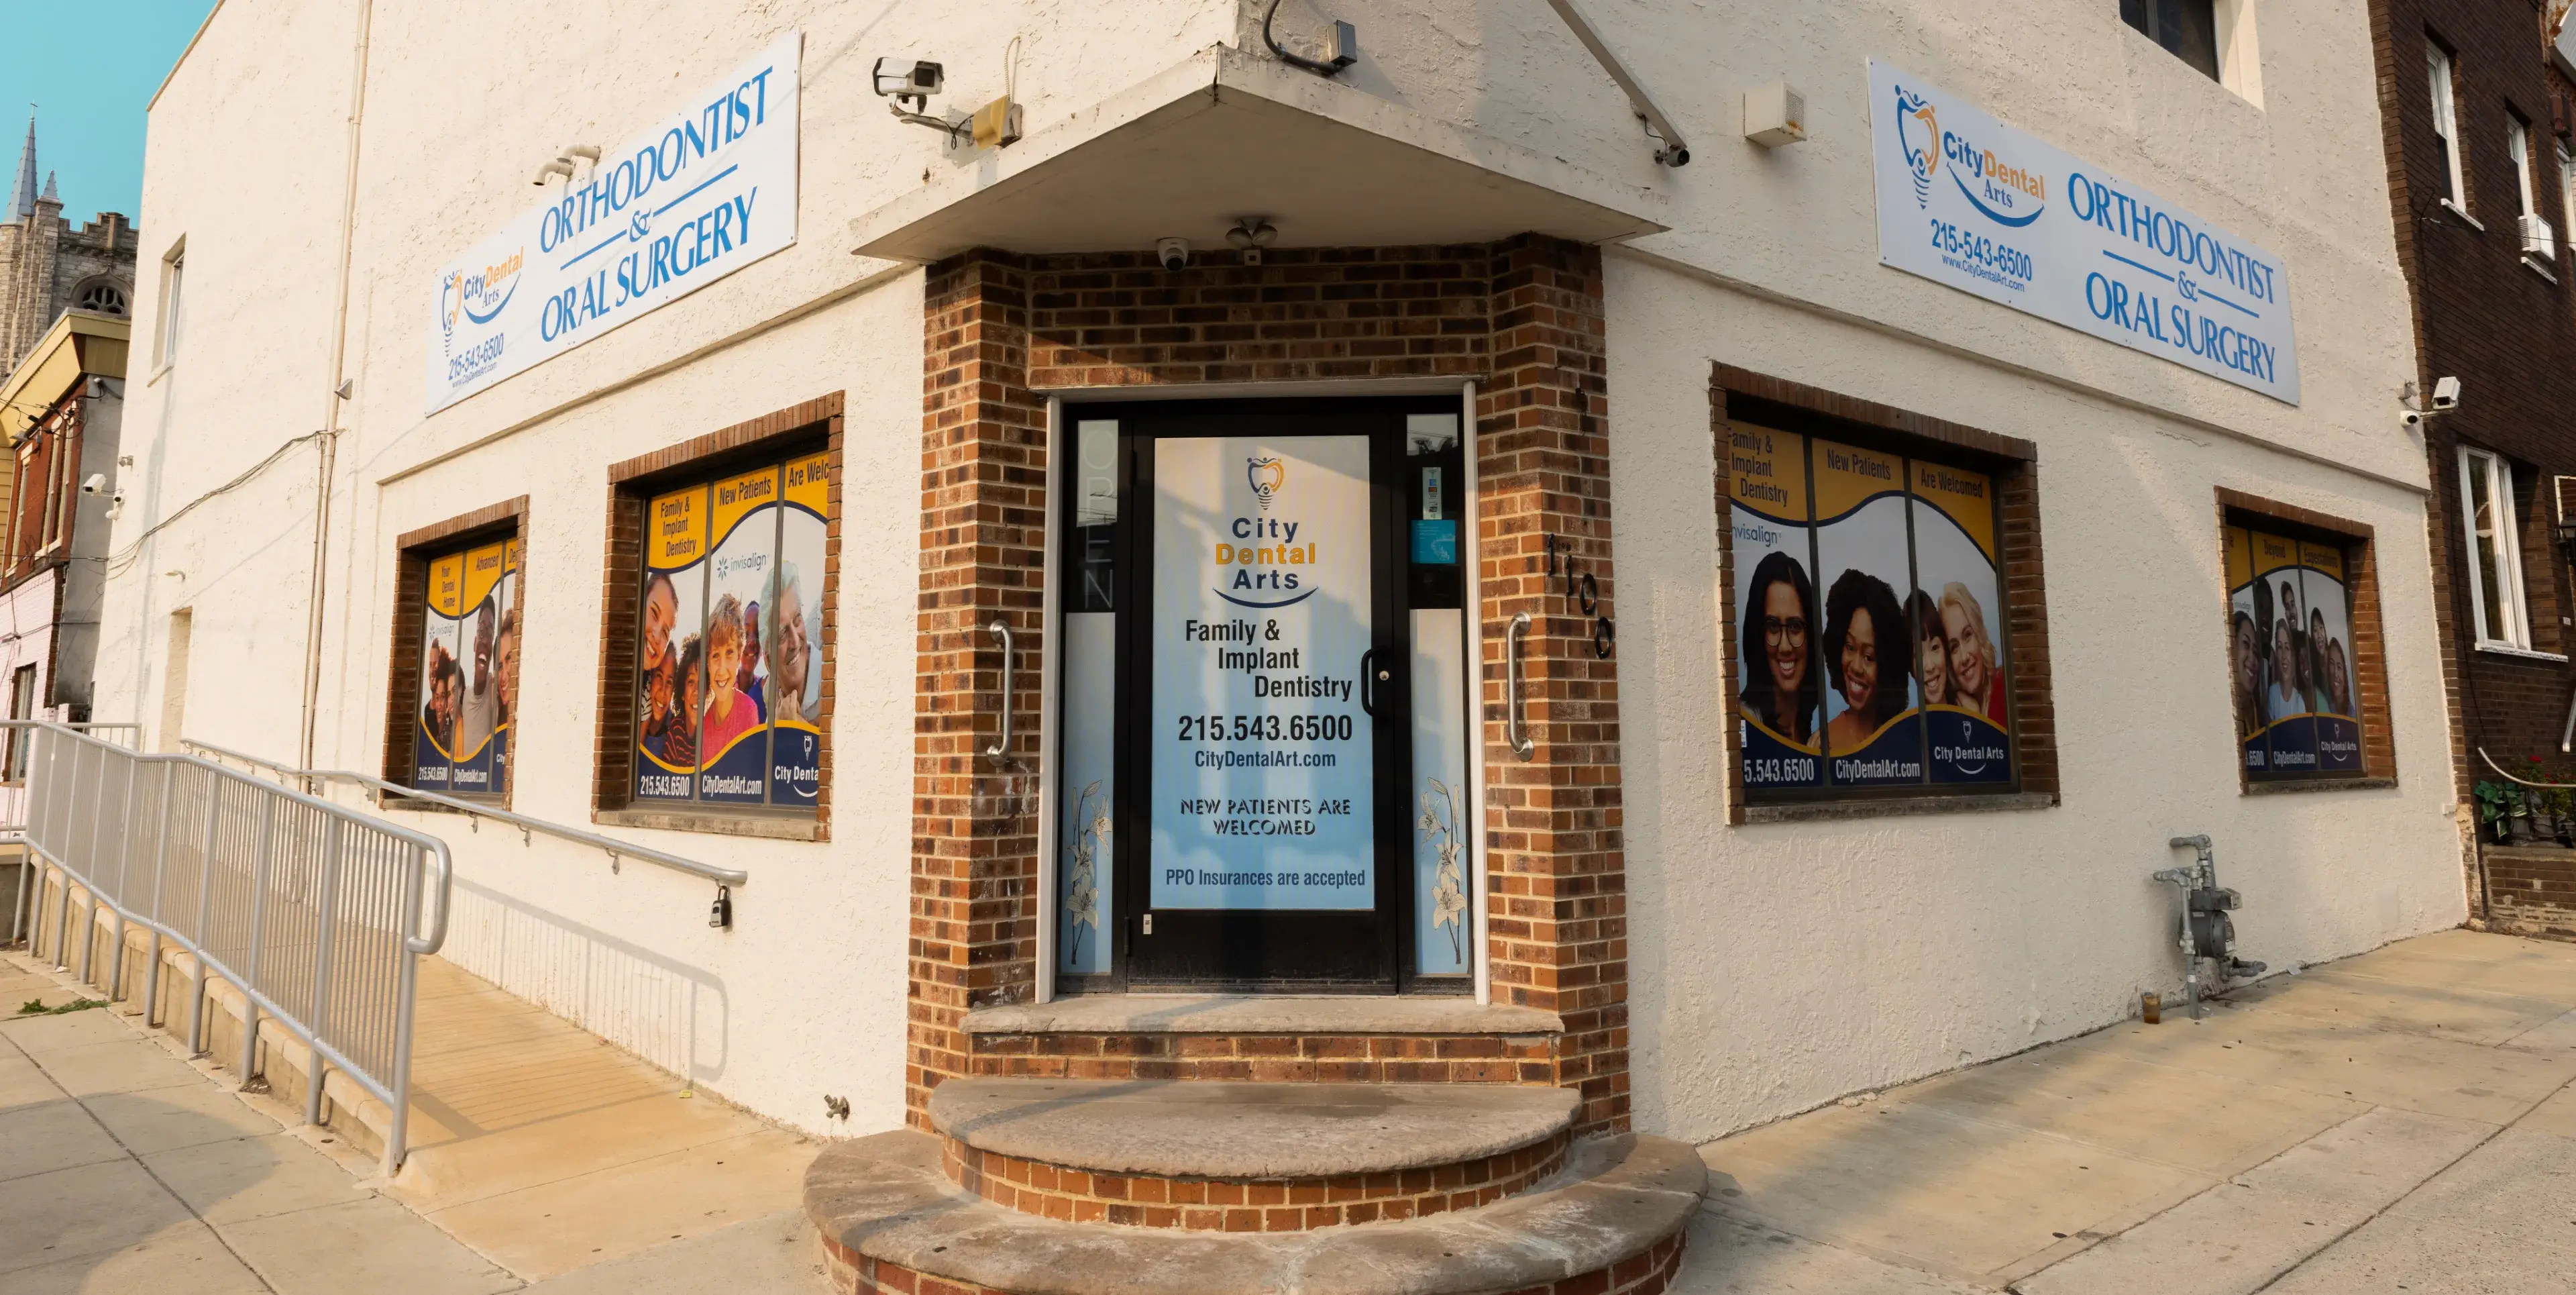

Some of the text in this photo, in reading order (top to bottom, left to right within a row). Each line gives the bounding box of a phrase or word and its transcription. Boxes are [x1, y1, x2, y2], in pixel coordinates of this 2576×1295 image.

[540, 66, 773, 254] ORTHODONTIST
[1984, 178, 2012, 208] Arts
[630, 209, 653, 242] &
[1931, 218, 2032, 281] 215-543-6500
[2068, 172, 2273, 304] ORTHODONTIST
[541, 186, 757, 342] ORAL SURGERY
[1942, 254, 2025, 292] www.CityDentalArt.com
[482, 288, 500, 308] Arts
[2178, 271, 2198, 301] &
[2086, 272, 2275, 383] ORAL SURGERY
[448, 333, 504, 380] 215-543-6500
[452, 362, 497, 388] www.CityDentalArt.com
[1766, 435, 1773, 454] &
[1731, 452, 1772, 477] Implant
[1827, 448, 1891, 480] New Patients
[788, 467, 803, 488] Are
[1921, 468, 1983, 498] Are Welcomed
[719, 476, 771, 506] New Patients
[1740, 478, 1787, 507] Dentistry
[660, 497, 690, 519] Family &
[1083, 429, 1118, 609] OPEN
[663, 517, 688, 538] Implant
[1232, 517, 1299, 543] City
[666, 538, 696, 558] Dentistry
[1216, 542, 1316, 565] Dental
[476, 552, 500, 571] Advanced
[731, 551, 767, 573] invisalign
[1232, 569, 1299, 590] Arts
[1547, 533, 1613, 660] 1100
[1186, 619, 1280, 645] Family &
[1218, 648, 1299, 673] Implant
[1254, 675, 1352, 702] Dentistry
[1179, 715, 1352, 741] 215.543.6500
[1934, 746, 2004, 762] City Dental Arts
[2273, 751, 2315, 767] CityDentalArt.com
[2321, 741, 2357, 753] City Dental Arts
[1195, 750, 1336, 770] CityDentalArt.com
[1835, 759, 1921, 782] CityDentalArt.com
[419, 766, 447, 781] 215.543.6500
[454, 768, 487, 784] CityDentalArt.com
[640, 775, 690, 796] 215.543.6500
[775, 765, 792, 784] City
[702, 775, 762, 797] CityDentalArt.com
[1181, 798, 1351, 815] NEW PATIENTS ARE
[1213, 819, 1316, 835] WELCOMED
[1166, 869, 1366, 889] PPO Insurances are accepted
